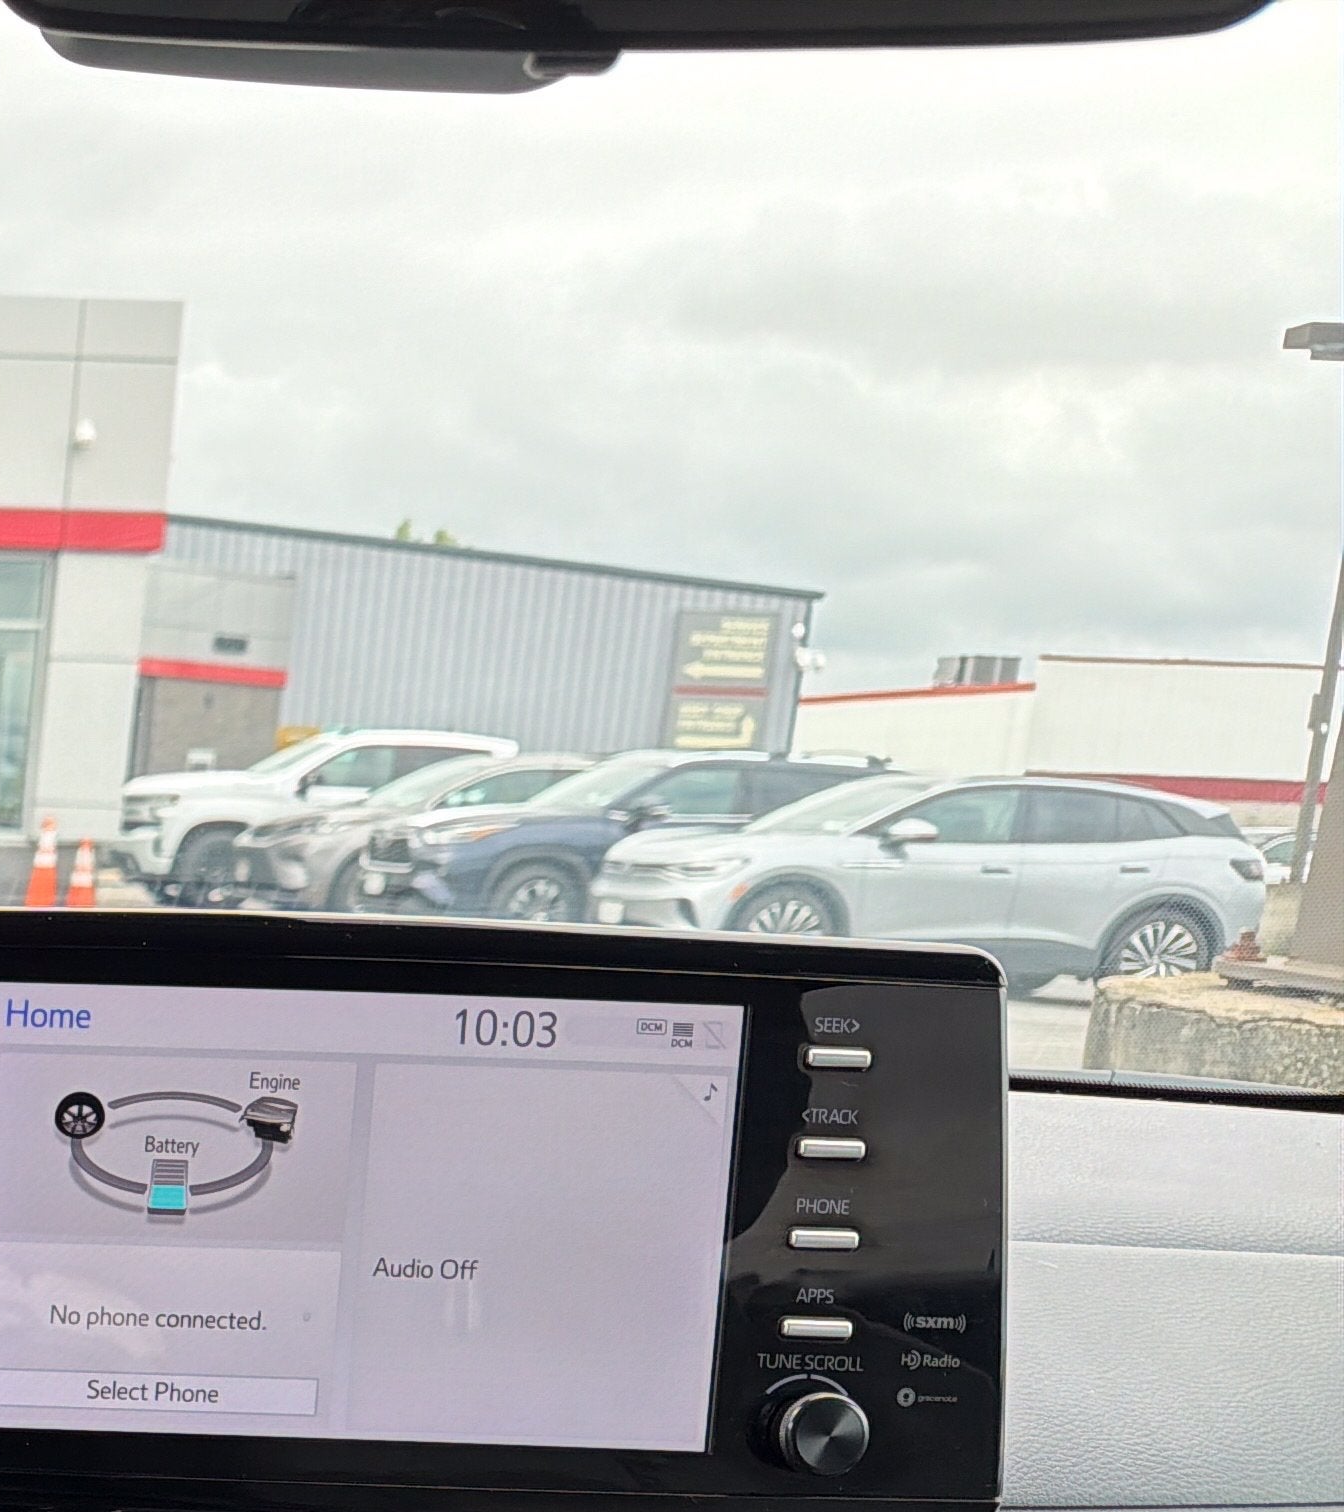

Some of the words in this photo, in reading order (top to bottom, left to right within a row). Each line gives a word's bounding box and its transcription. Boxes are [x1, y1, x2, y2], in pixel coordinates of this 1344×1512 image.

[6, 999, 92, 1030] Home
[455, 1008, 558, 1048] 10:03
[640, 1022, 664, 1033] DCM
[671, 1038, 693, 1049] DCM
[249, 1072, 300, 1094] Engine
[145, 1136, 200, 1158] Battery
[796, 1198, 850, 1215] PHONE
[372, 1258, 434, 1280] Audio
[440, 1259, 479, 1280] Off
[796, 1288, 834, 1304] APPS
[50, 1305, 81, 1326] No
[86, 1306, 150, 1330] phone
[155, 1310, 267, 1332] connected.
[757, 1353, 802, 1370] TUNE
[805, 1355, 864, 1372] SCROLL
[923, 1354, 961, 1368] Radio
[86, 1380, 148, 1402] Select
[154, 1382, 220, 1404] Phone
